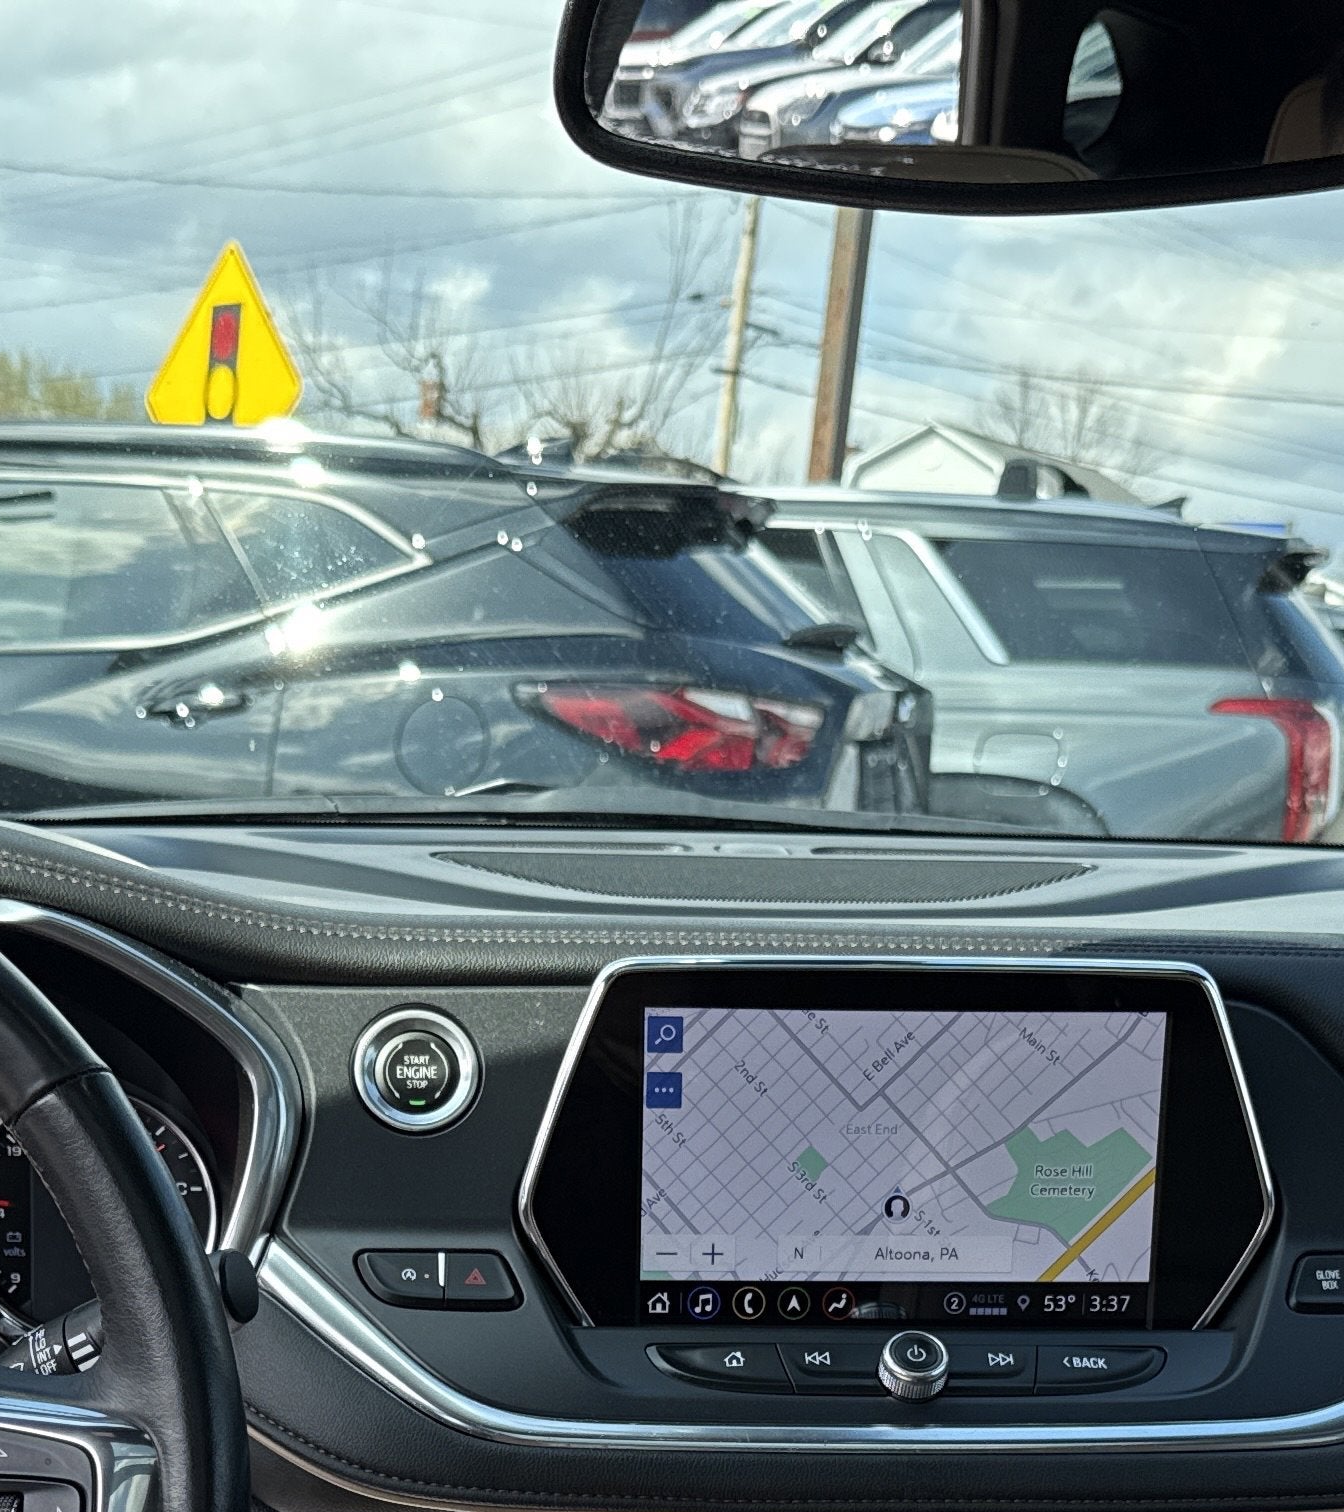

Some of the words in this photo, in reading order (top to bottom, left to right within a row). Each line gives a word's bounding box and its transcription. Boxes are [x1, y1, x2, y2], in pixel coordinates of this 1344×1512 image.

[815, 1018, 831, 1035] St
[1019, 1026, 1046, 1055] Main
[1045, 1049, 1061, 1066] St
[403, 1055, 430, 1065] START
[862, 1069, 874, 1082] E
[871, 1048, 895, 1073] Bell
[893, 1031, 916, 1053] Ave
[396, 1066, 438, 1079] ENGINE
[733, 1060, 756, 1086] 2nd
[753, 1080, 769, 1098] St
[406, 1080, 429, 1089] STOP
[655, 1113, 674, 1134] 5th
[671, 1130, 687, 1148] St
[846, 1124, 872, 1135] East
[874, 1124, 898, 1135] End
[6, 1145, 22, 1157] 19
[1035, 1164, 1068, 1178] Rose
[1071, 1164, 1093, 1178] Hill
[177, 1182, 188, 1195] C
[787, 1160, 799, 1174] S
[794, 1169, 816, 1192] 3rd
[812, 1187, 828, 1205] St
[646, 1188, 668, 1210] Ave
[1030, 1184, 1095, 1200] Cemetery
[914, 1210, 925, 1223] S
[3, 1248, 26, 1258] volts
[794, 1248, 805, 1259] N
[874, 1248, 935, 1263] Altoona,
[939, 1248, 959, 1260] PA
[10, 1273, 21, 1284] 9
[1315, 1269, 1342, 1280] GLOVE
[1321, 1280, 1339, 1290] BOX
[988, 1294, 1005, 1304] LTE
[1043, 1295, 1076, 1312] 53°
[1089, 1295, 1131, 1312] 3:37
[35, 1338, 47, 1352] LO
[36, 1347, 52, 1364] INT
[39, 1359, 57, 1376] OFF
[1072, 1356, 1108, 1370] BACK
